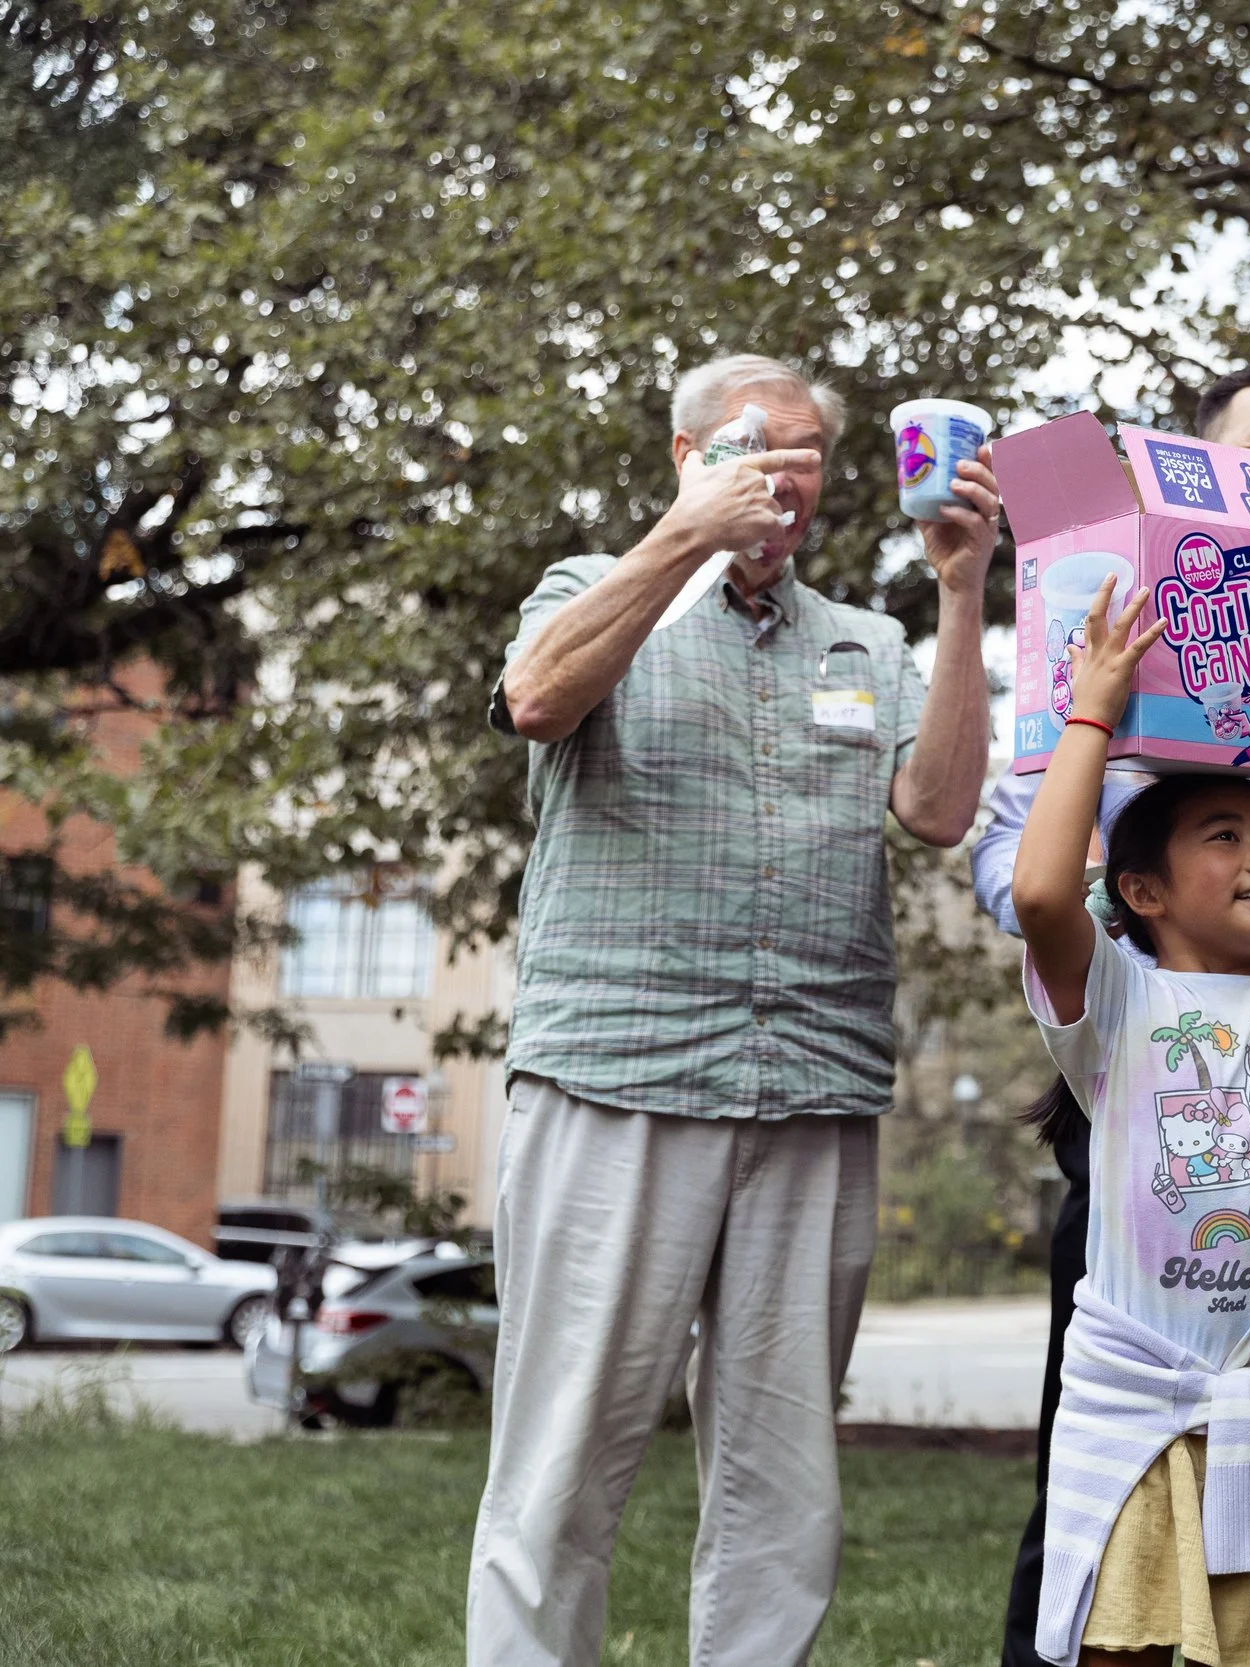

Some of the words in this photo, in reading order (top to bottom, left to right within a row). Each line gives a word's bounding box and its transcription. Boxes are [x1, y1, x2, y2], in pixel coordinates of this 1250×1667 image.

[1158, 456, 1206, 474] CLASSIC
[1161, 467, 1212, 490] PACK
[1182, 486, 1204, 503] 12
[1180, 545, 1218, 572] FUN
[1185, 569, 1221, 584] sweets
[1020, 719, 1036, 751] 12
[1208, 1296, 1247, 1313] And
